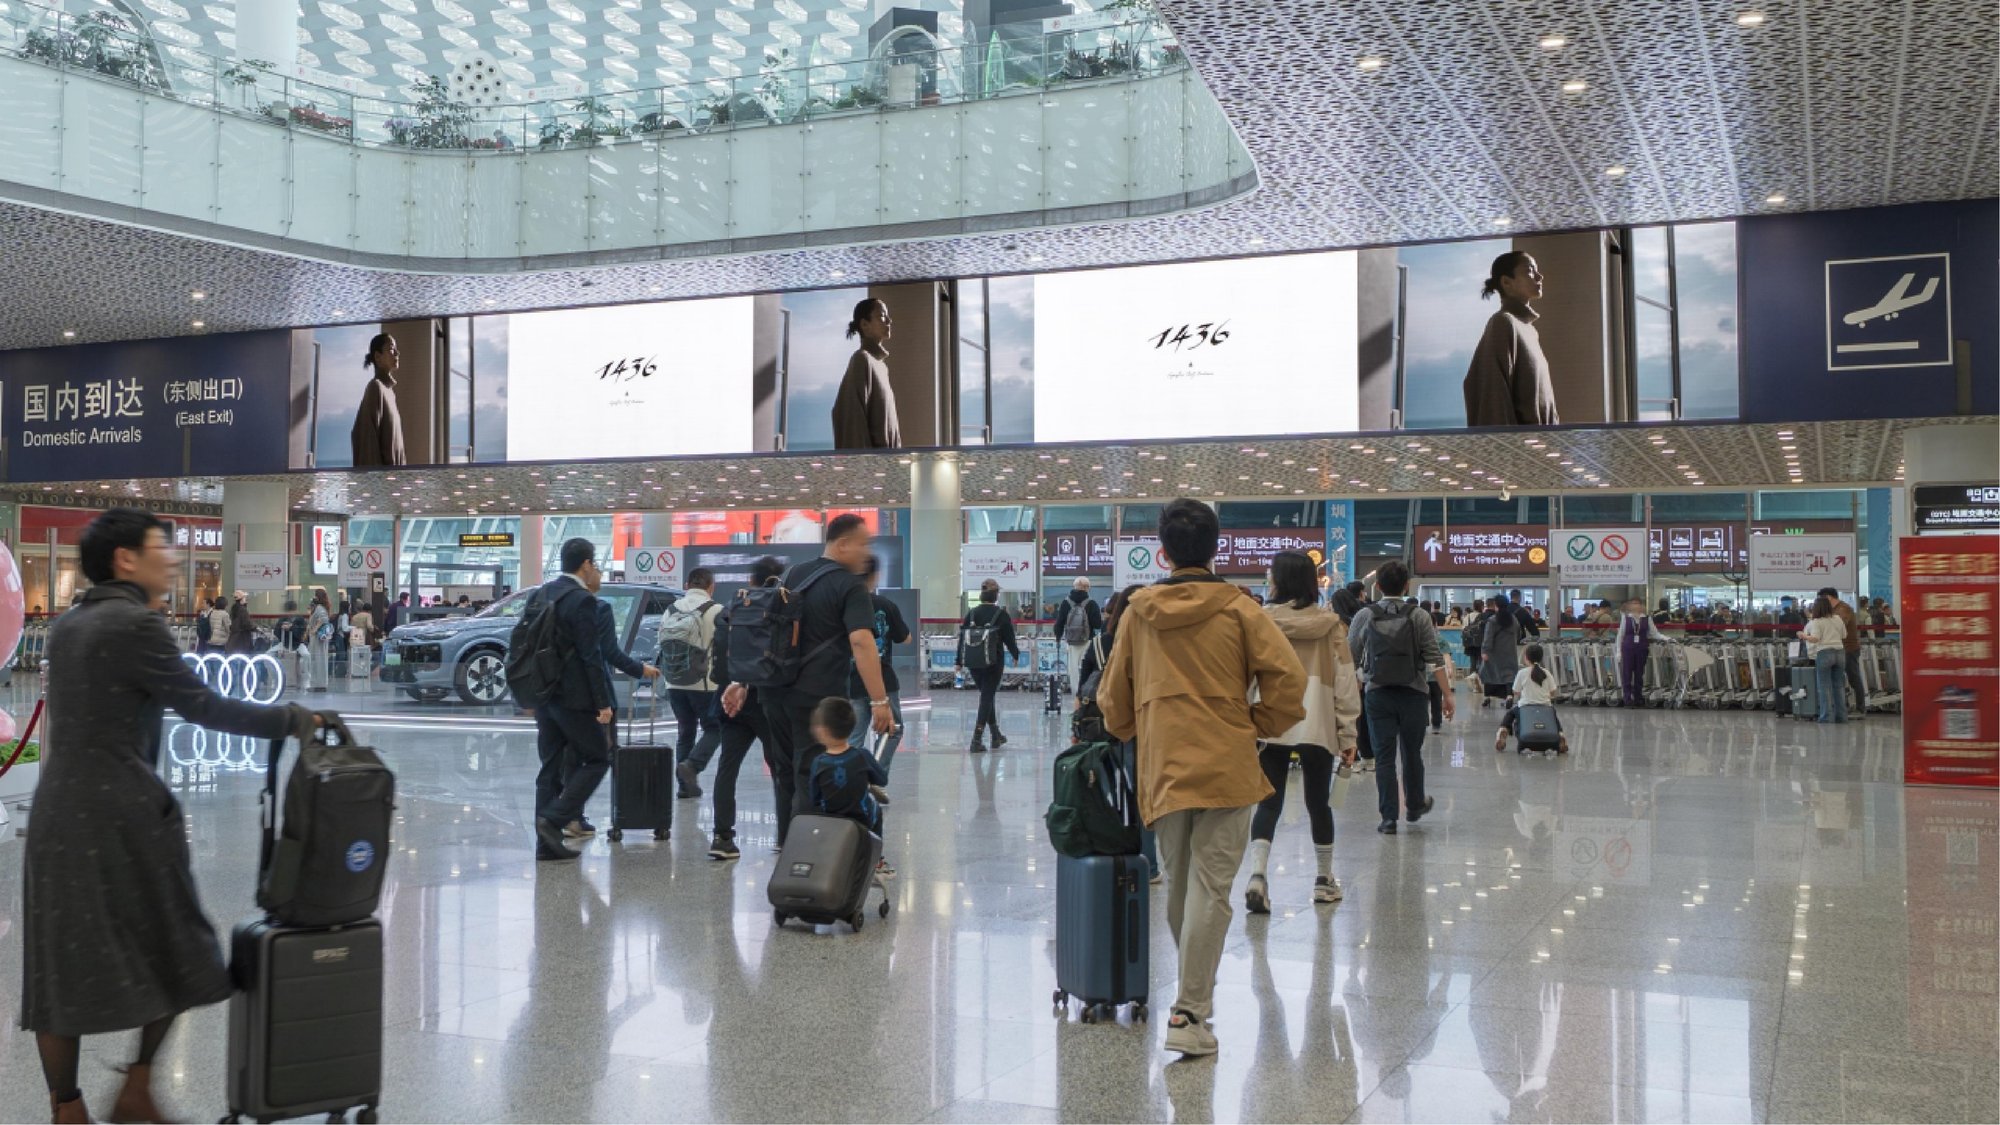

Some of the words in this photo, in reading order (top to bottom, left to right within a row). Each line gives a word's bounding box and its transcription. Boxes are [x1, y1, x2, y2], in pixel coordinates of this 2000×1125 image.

[1147, 318, 1231, 352] 1436
[595, 354, 657, 383] 1436
[24, 377, 144, 422] 国内到达
[176, 410, 205, 428] (East
[208, 409, 233, 426] Exit)
[23, 429, 86, 447] Domestic
[89, 426, 142, 444] Arrivals
